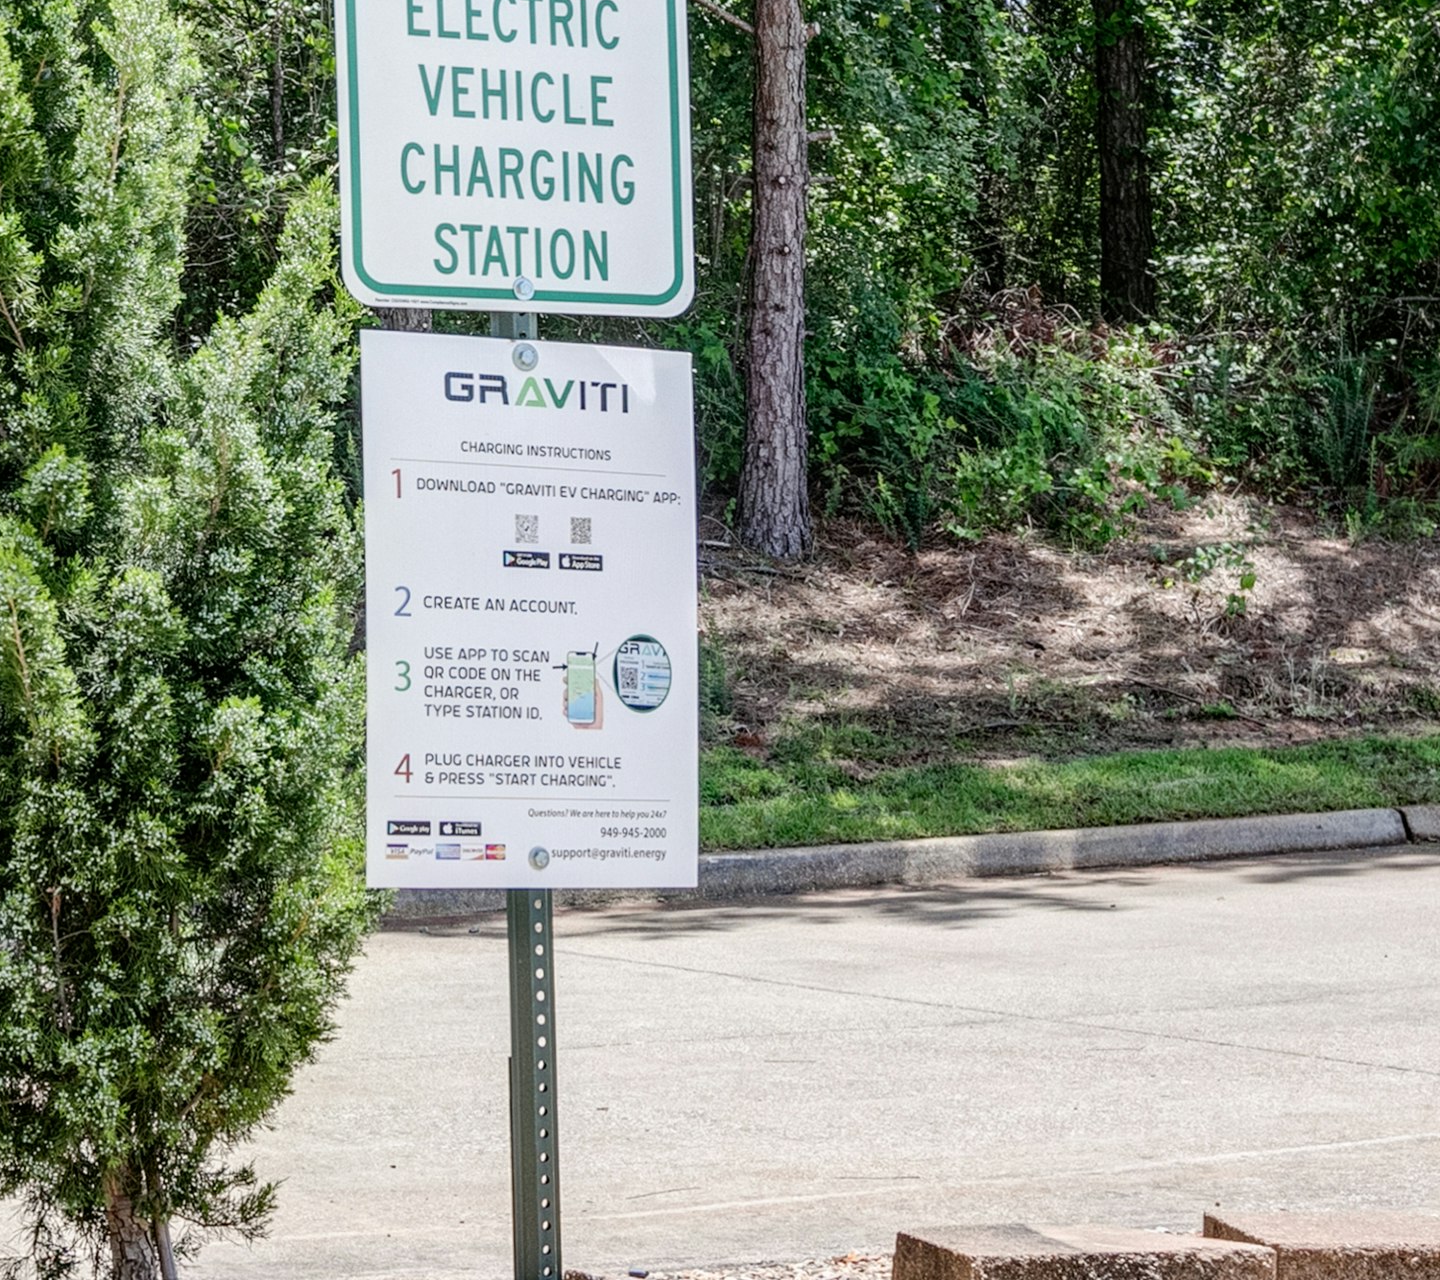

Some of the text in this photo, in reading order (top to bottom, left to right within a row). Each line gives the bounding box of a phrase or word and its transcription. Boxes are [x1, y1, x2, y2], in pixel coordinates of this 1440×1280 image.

[418, 63, 615, 128] VEHICLE
[400, 141, 636, 206] CHARGING
[433, 222, 610, 282] STATION
[444, 371, 629, 413] GRAVITI
[460, 440, 612, 462] CHARGING INSTRUCTIONS
[391, 468, 402, 499] 1
[416, 477, 682, 506] DOWNLOAD "GRAVITI EV CHARGING" APP:
[572, 560, 601, 571] App Store
[394, 585, 412, 617] 2
[423, 595, 579, 616] CREATE AN ACCOUNT.
[424, 646, 551, 663] USE APP TO SCAN
[394, 660, 412, 692] 3
[423, 665, 542, 682] QR CODE ON THE
[423, 684, 520, 701] CHARGER, OR
[423, 703, 543, 721] TYPE STATION ID.
[393, 753, 414, 784] 4
[424, 752, 622, 770] PLUG CHARGER INTO VEHICLE
[424, 772, 434, 785] &
[438, 772, 485, 785] PRESS
[488, 772, 537, 787] "START
[527, 807, 667, 821] Questions? We are here to help you 24x7
[600, 826, 667, 839] 949-945-2000
[551, 846, 667, 862] support@graviti.energy
